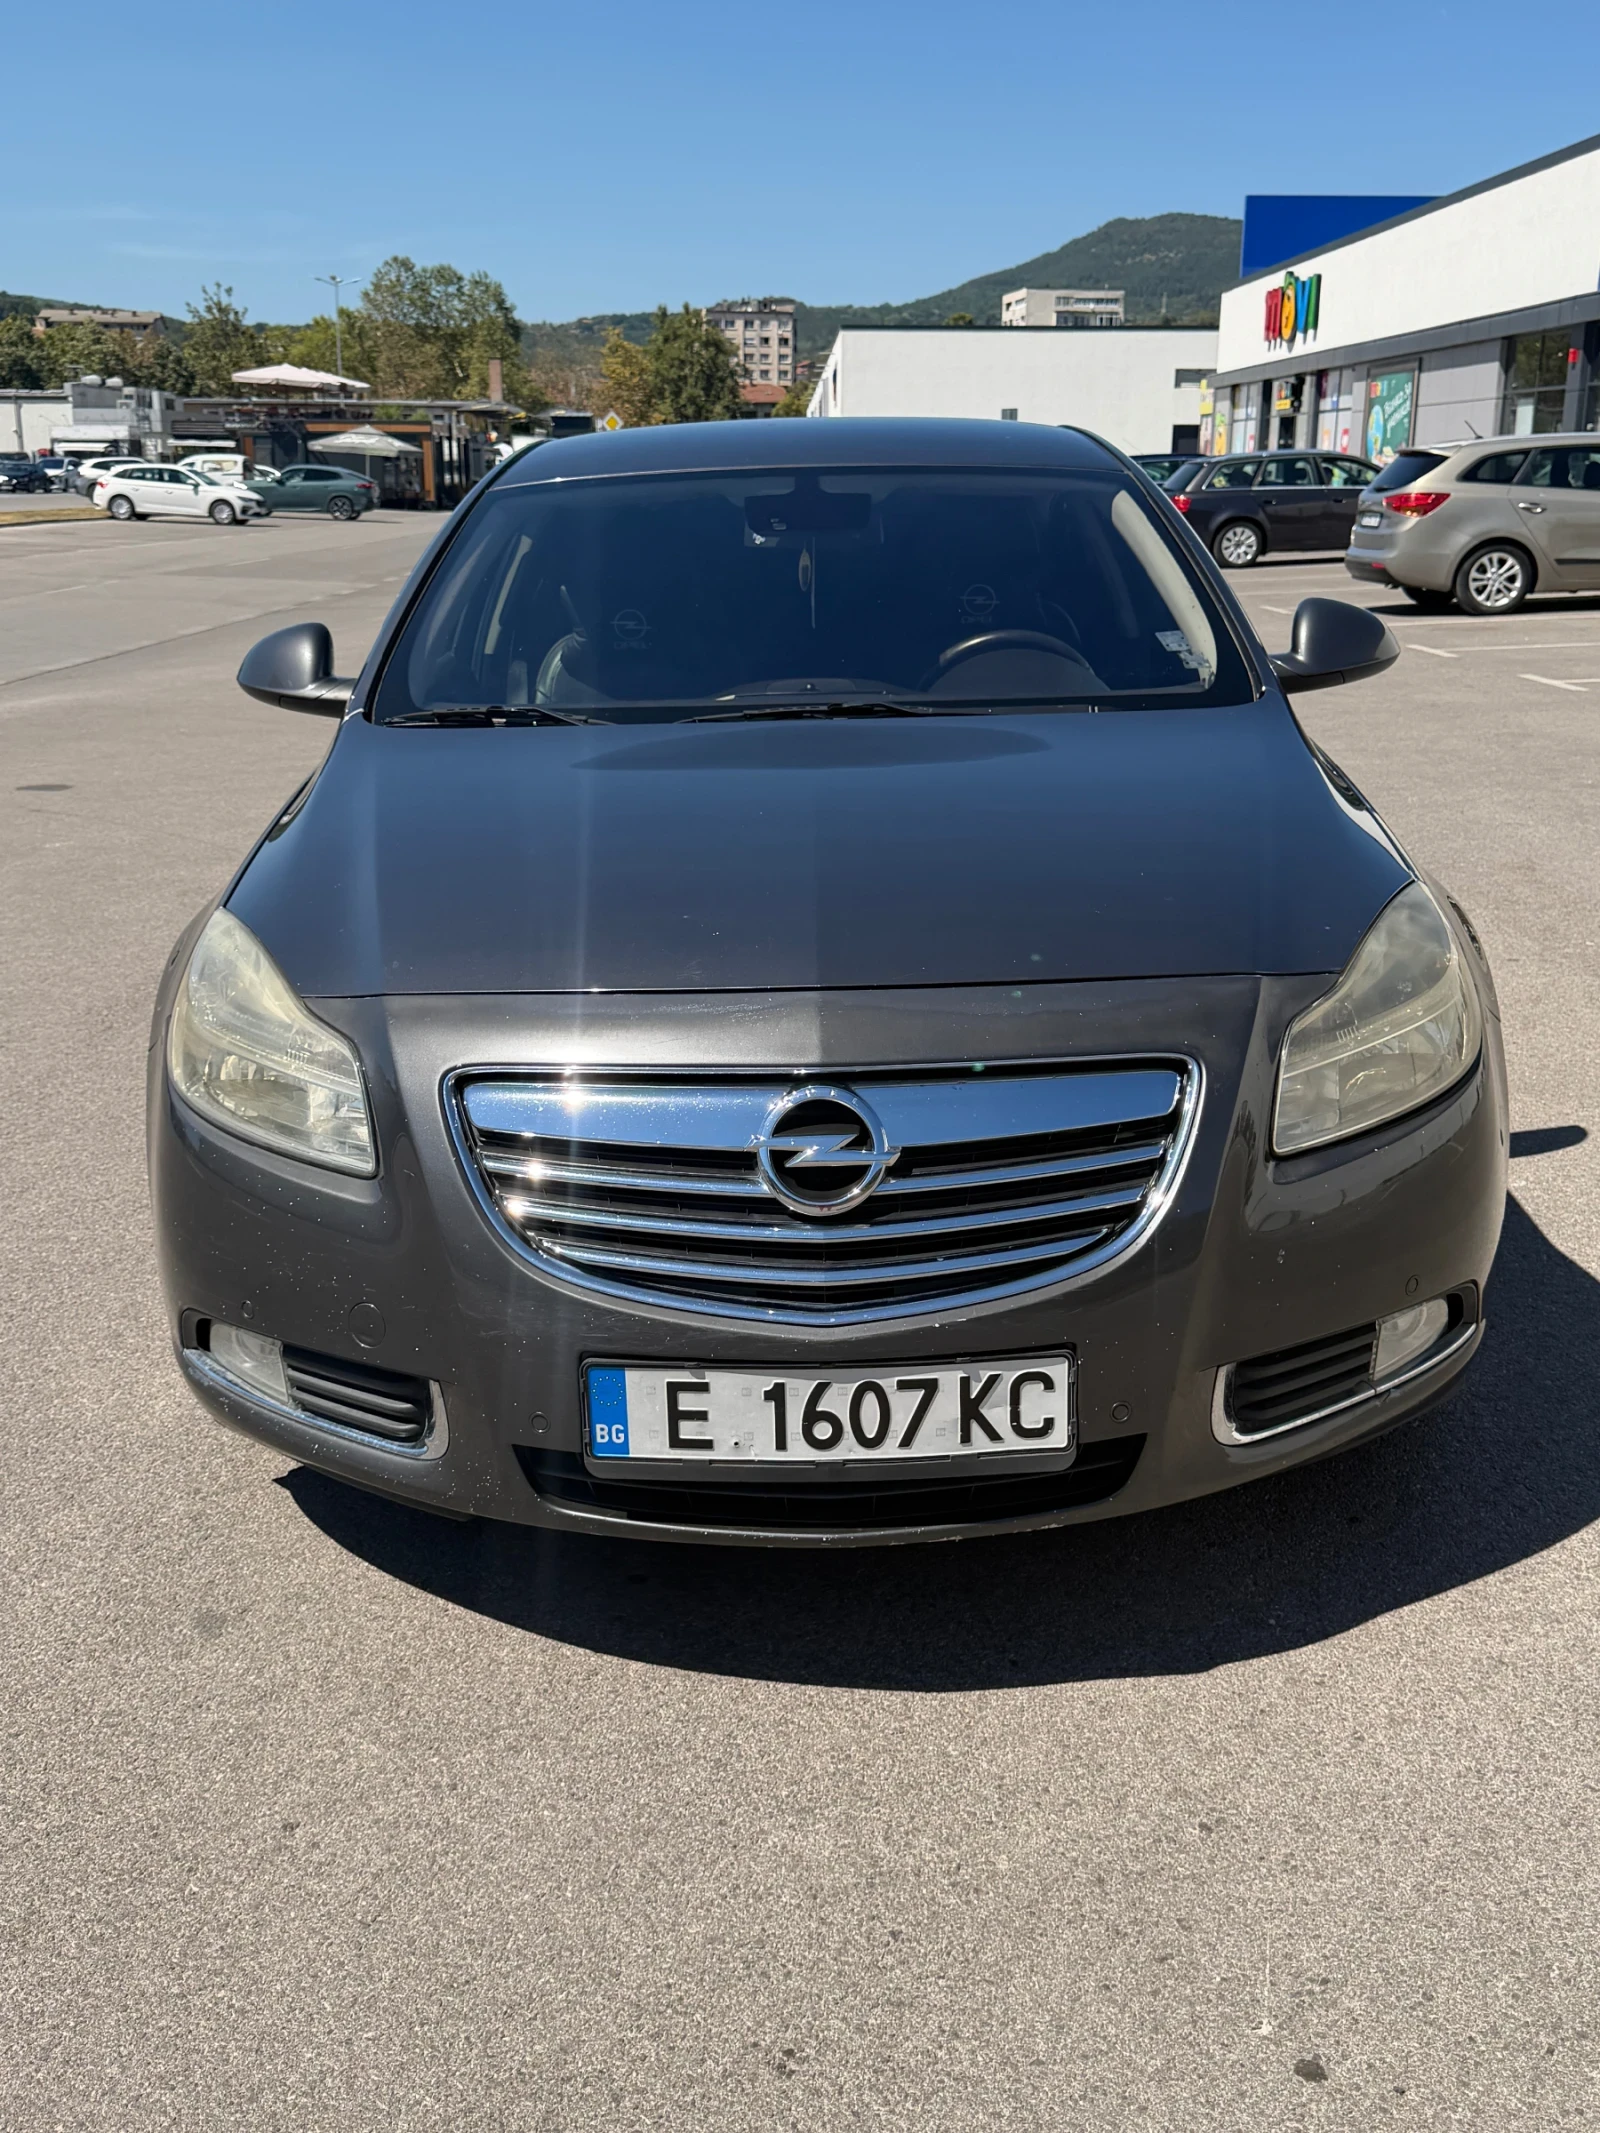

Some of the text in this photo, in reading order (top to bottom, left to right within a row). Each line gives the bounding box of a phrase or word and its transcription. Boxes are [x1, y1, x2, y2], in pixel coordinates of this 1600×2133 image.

[595, 1424, 625, 1444] BG
[666, 1371, 1055, 1452] E 1607 KC
